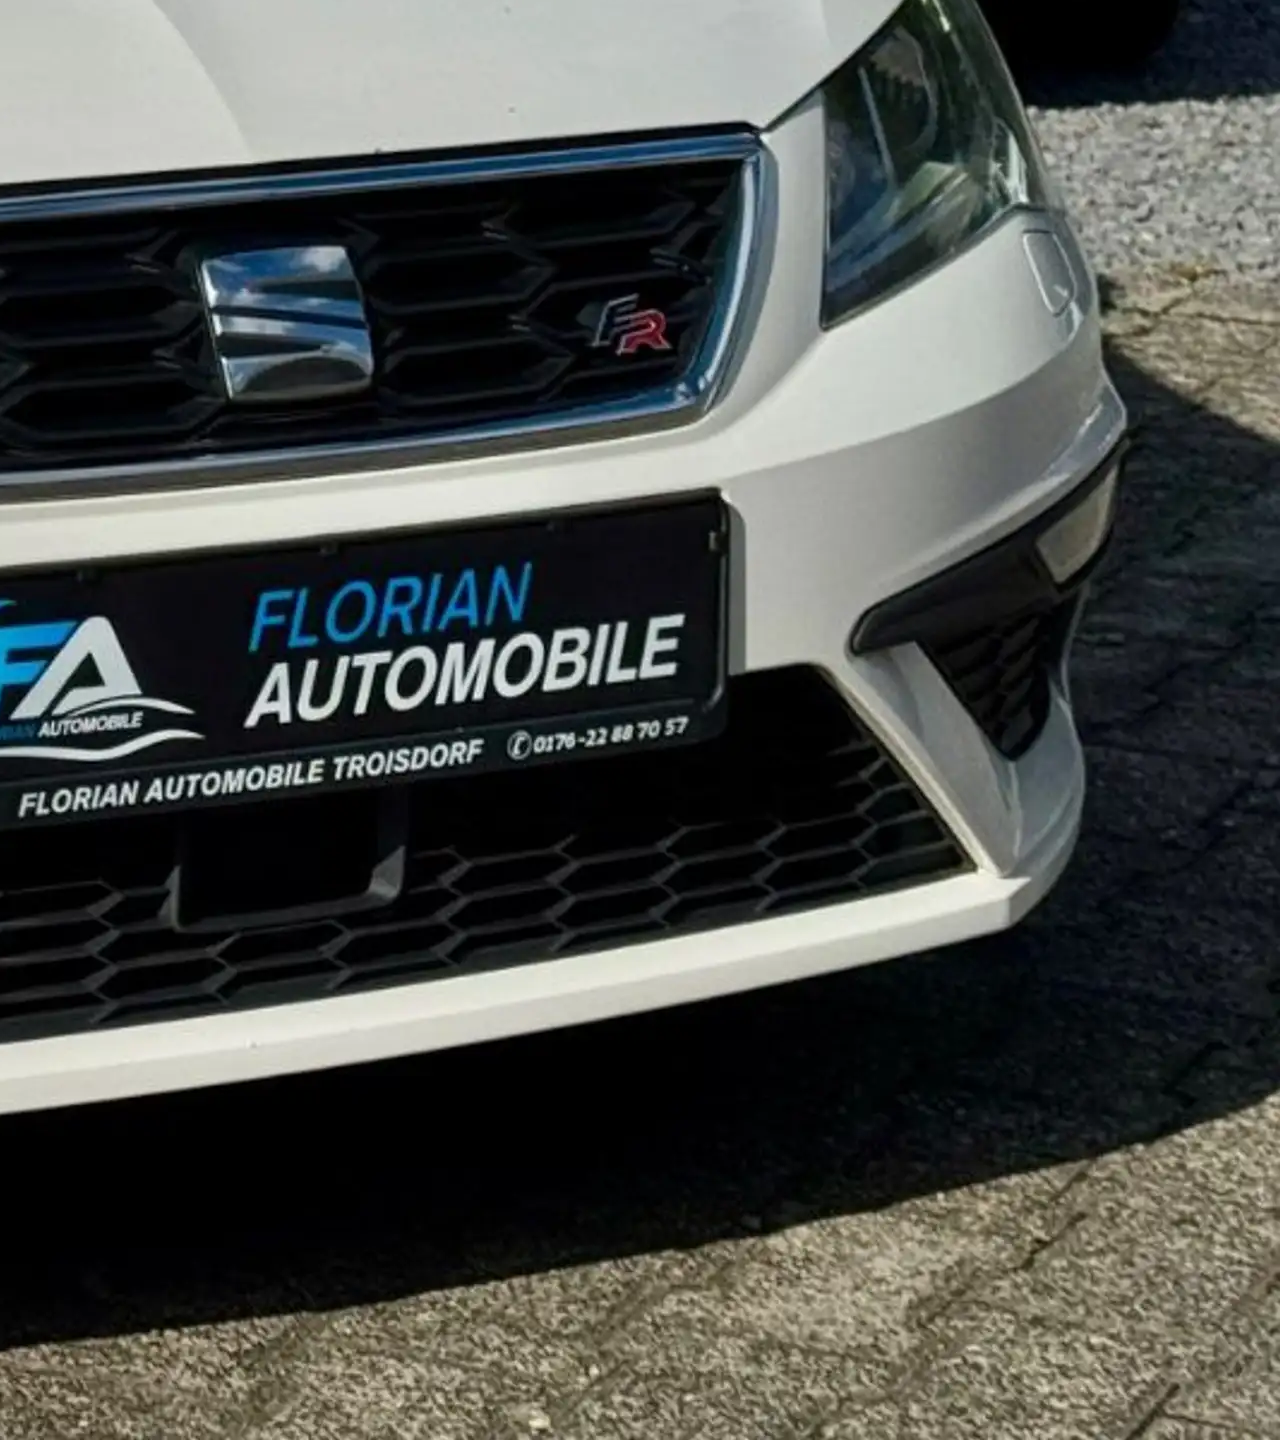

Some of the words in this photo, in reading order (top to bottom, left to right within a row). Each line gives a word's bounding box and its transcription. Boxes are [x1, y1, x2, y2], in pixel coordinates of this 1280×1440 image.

[249, 561, 532, 652] FLORIAN
[243, 613, 686, 728] AUTOMOBILE
[39, 711, 144, 738] AUTOMOBILE
[533, 727, 608, 754] 0176-22
[610, 724, 634, 743] 88
[637, 720, 661, 739] 70
[664, 715, 690, 736] 57
[18, 780, 140, 818] FLORIAN
[142, 758, 325, 804] AUTOMOBILE
[332, 738, 485, 782] TROISDORF
